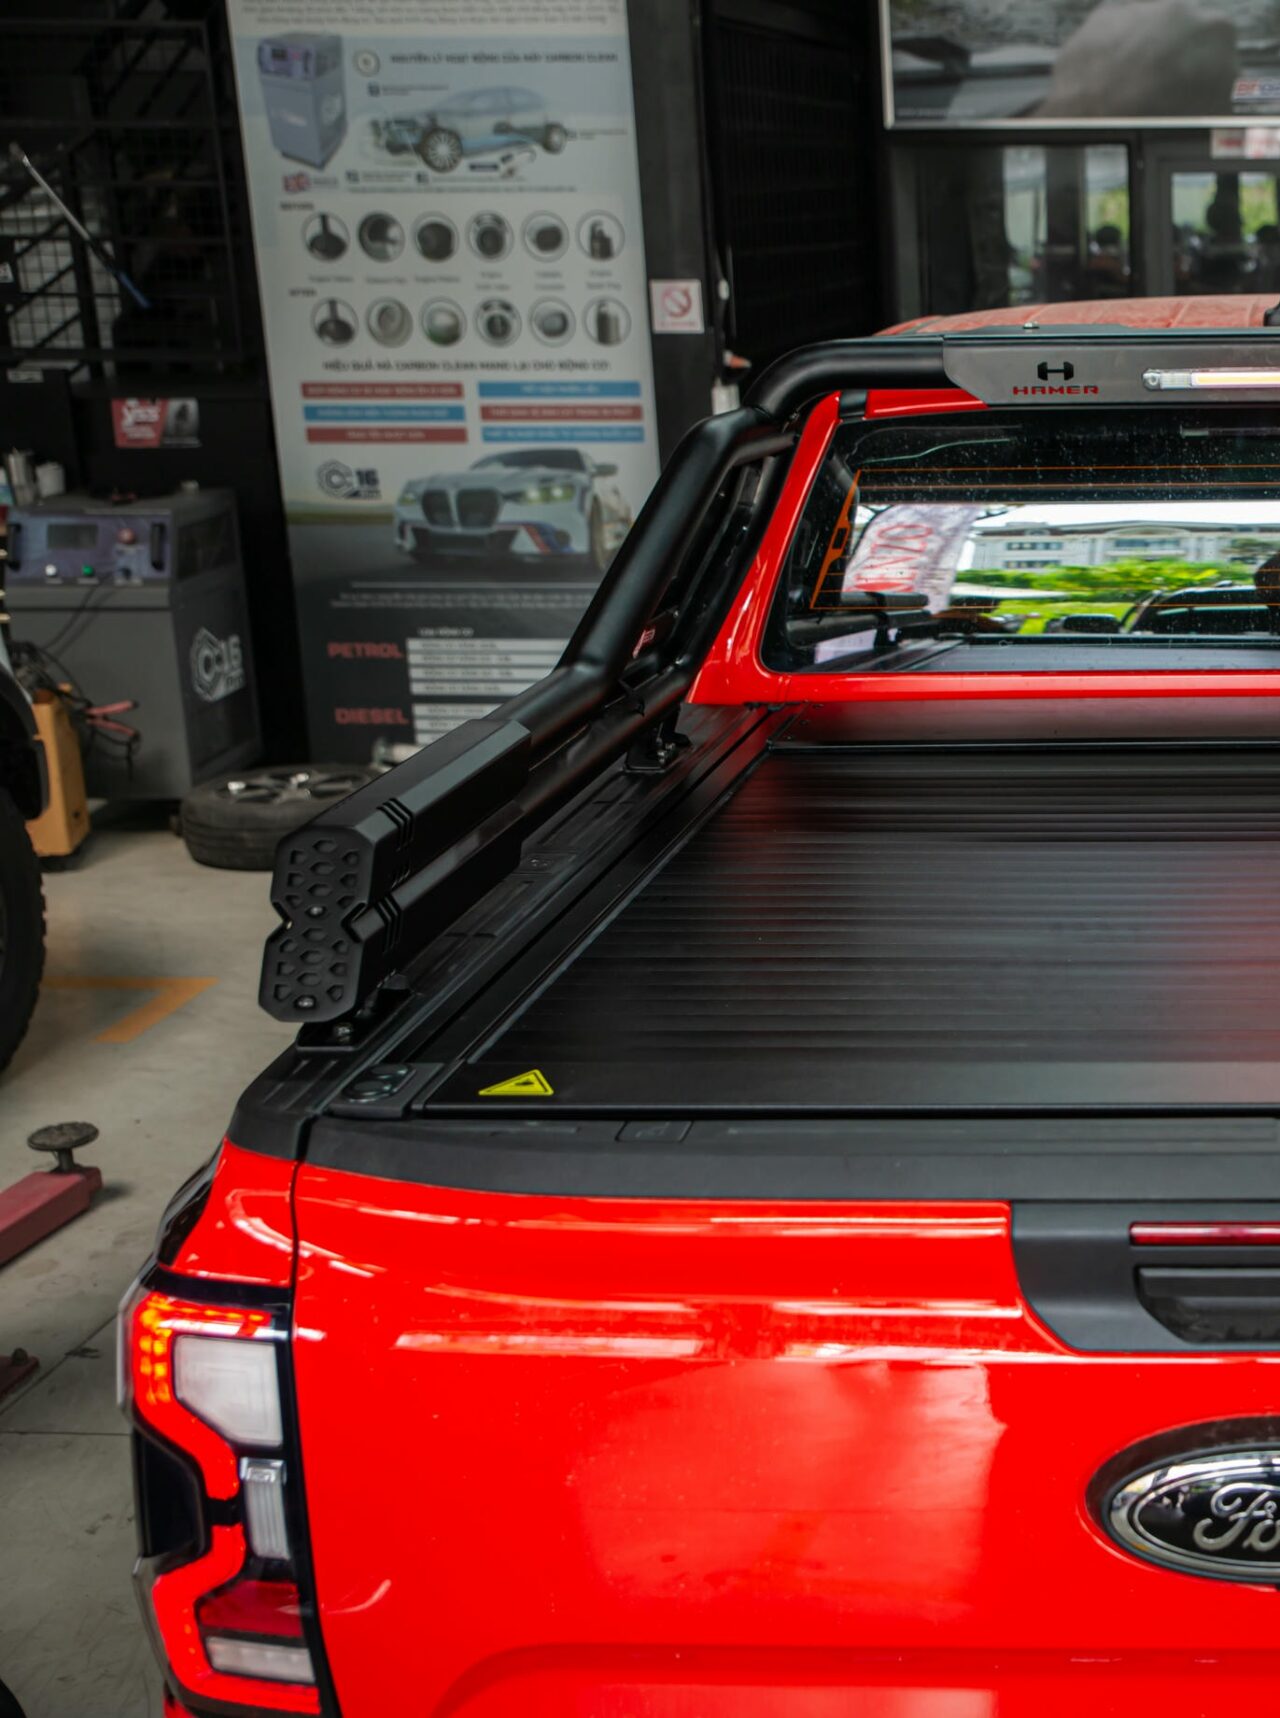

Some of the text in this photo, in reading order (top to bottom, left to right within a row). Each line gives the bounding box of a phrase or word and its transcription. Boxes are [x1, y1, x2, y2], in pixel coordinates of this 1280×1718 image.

[1012, 385, 1099, 395] HAMER
[327, 642, 405, 659] PETROL
[334, 707, 408, 725] DIESEL
